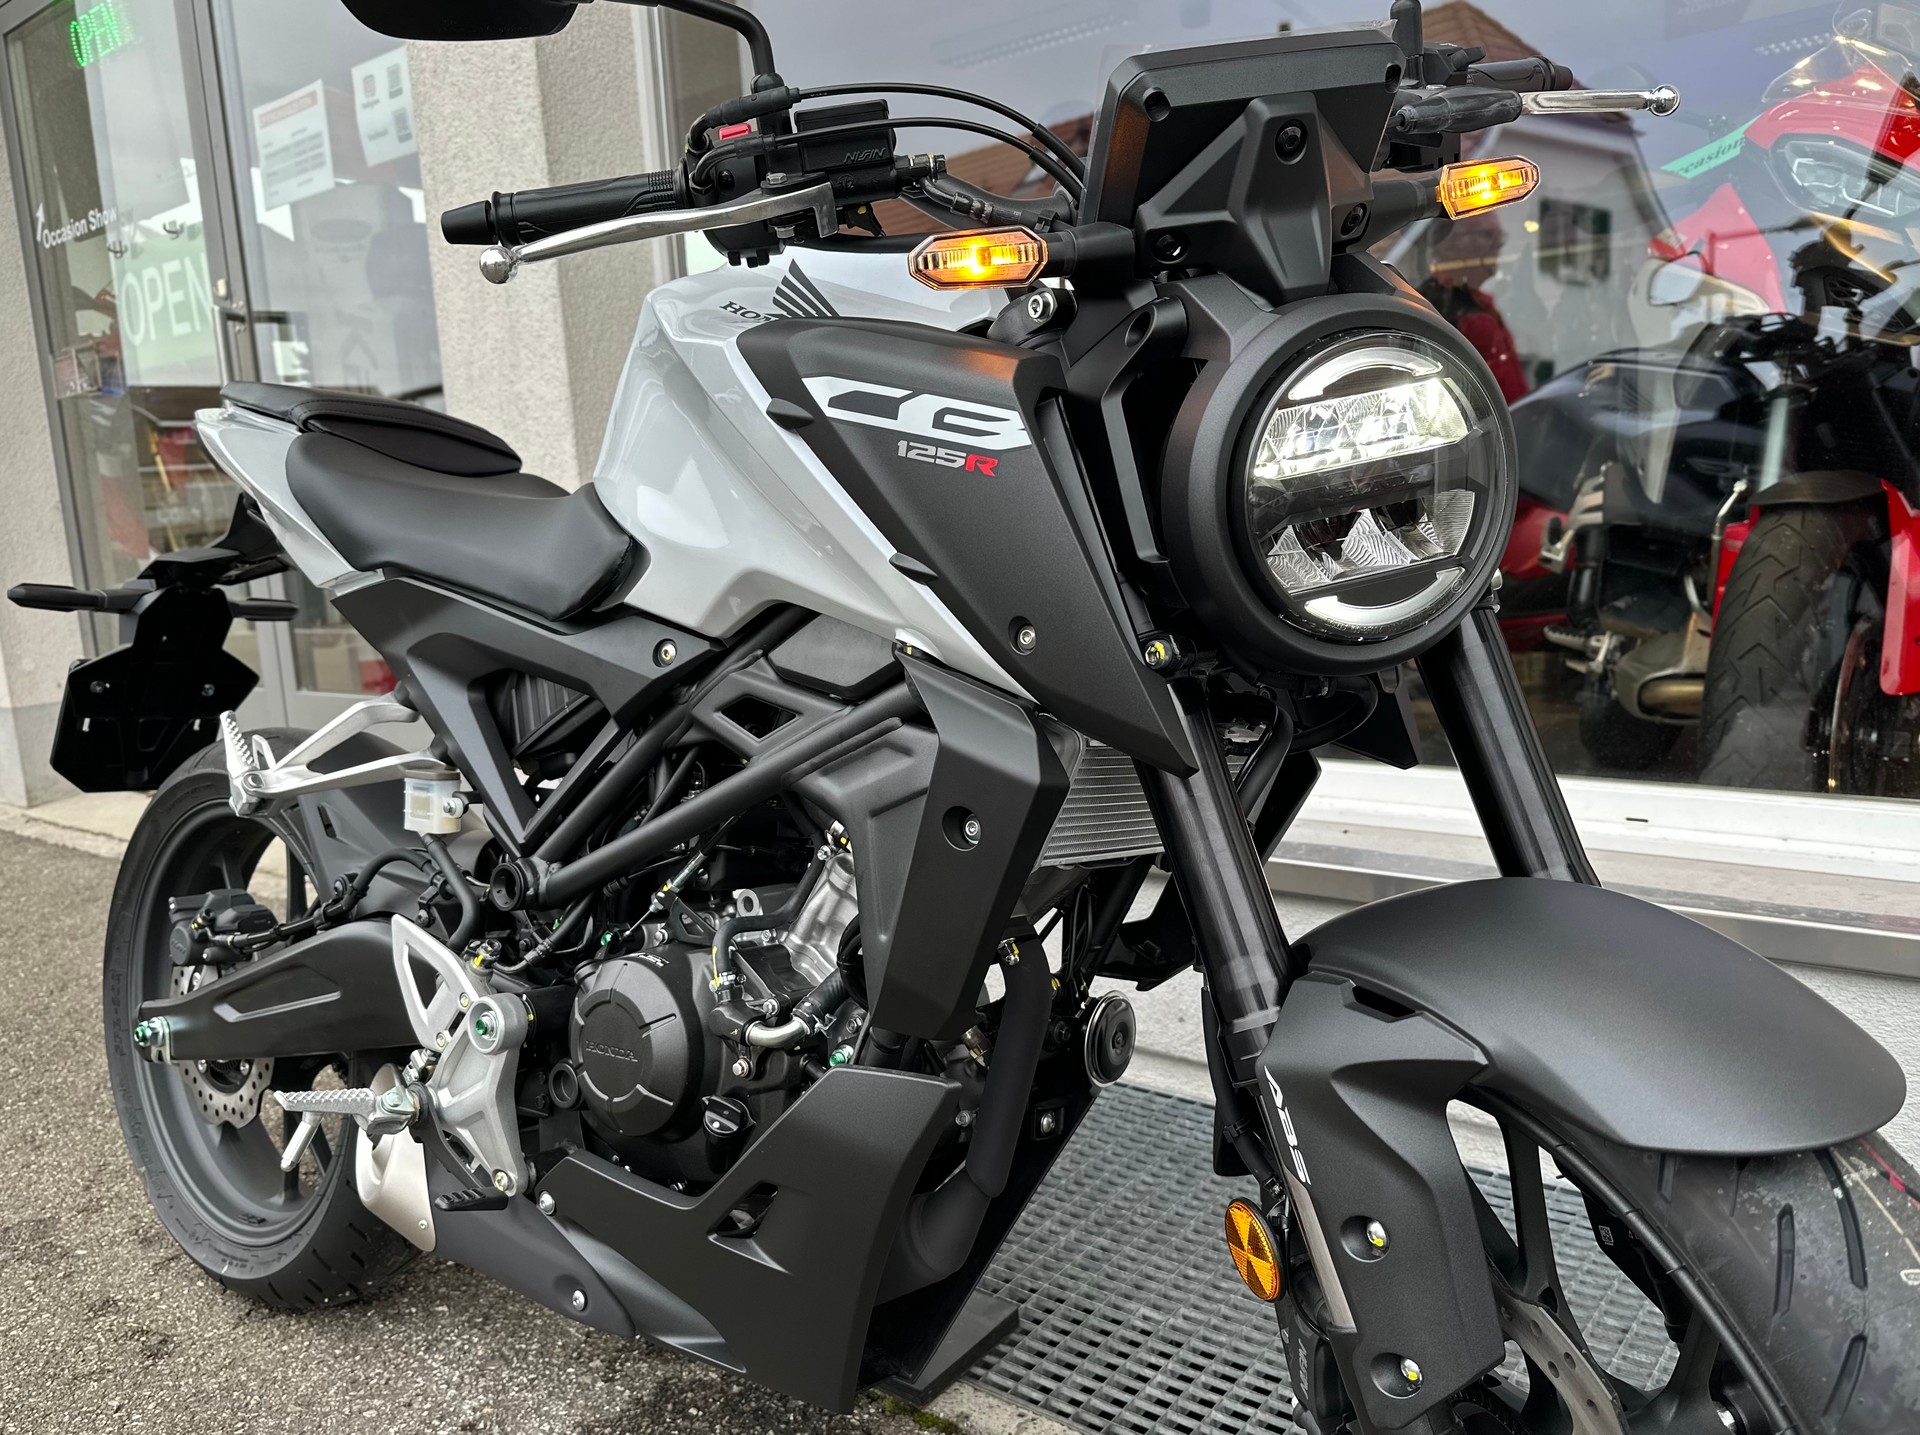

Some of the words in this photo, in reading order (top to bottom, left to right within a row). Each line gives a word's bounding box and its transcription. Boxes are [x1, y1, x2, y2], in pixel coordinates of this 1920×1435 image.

[70, 0, 122, 67] OPEN
[42, 217, 88, 250] Occasion
[87, 206, 119, 231] Show
[120, 251, 213, 347] OPEN
[801, 376, 1033, 451] CB
[897, 439, 999, 477] 125R
[584, 1040, 639, 1063] HONDA
[1263, 1064, 1312, 1186] ABS
